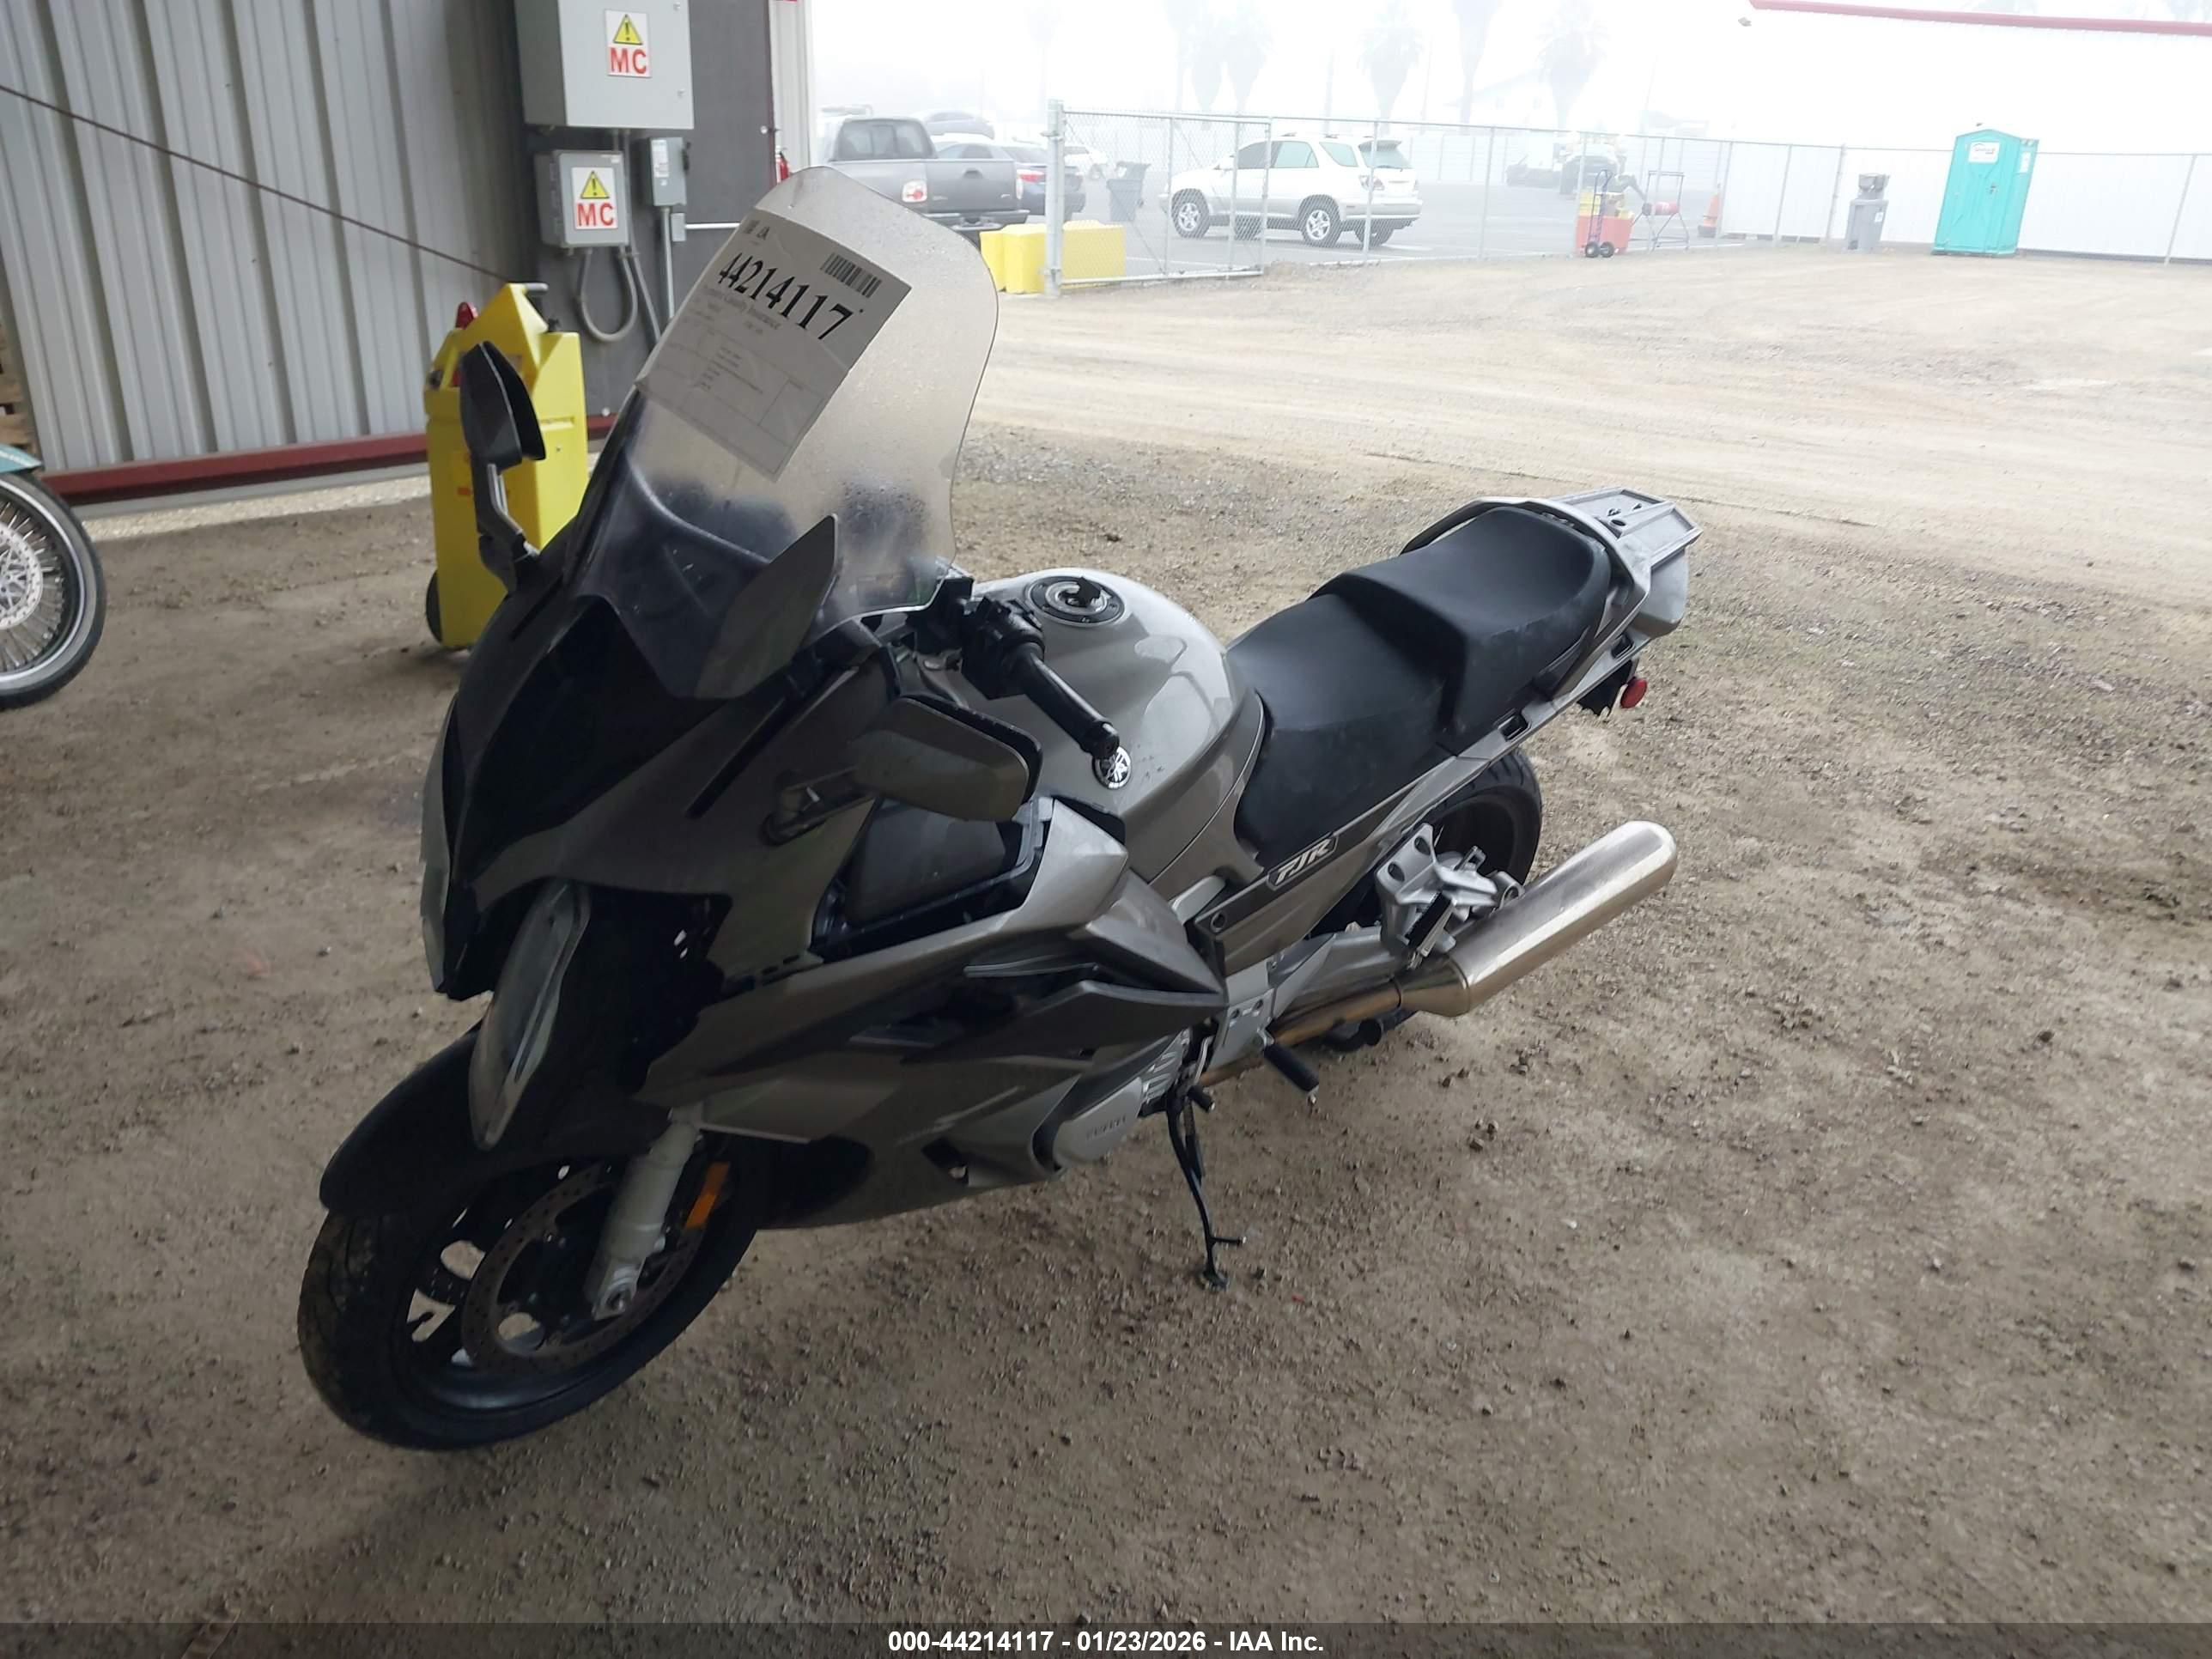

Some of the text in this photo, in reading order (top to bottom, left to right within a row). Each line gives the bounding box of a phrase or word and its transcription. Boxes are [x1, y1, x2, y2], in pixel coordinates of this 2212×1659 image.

[610, 47, 647, 75] MC
[577, 203, 614, 227] MC
[718, 252, 854, 340] 44214117
[1274, 838, 1332, 885] FJR
